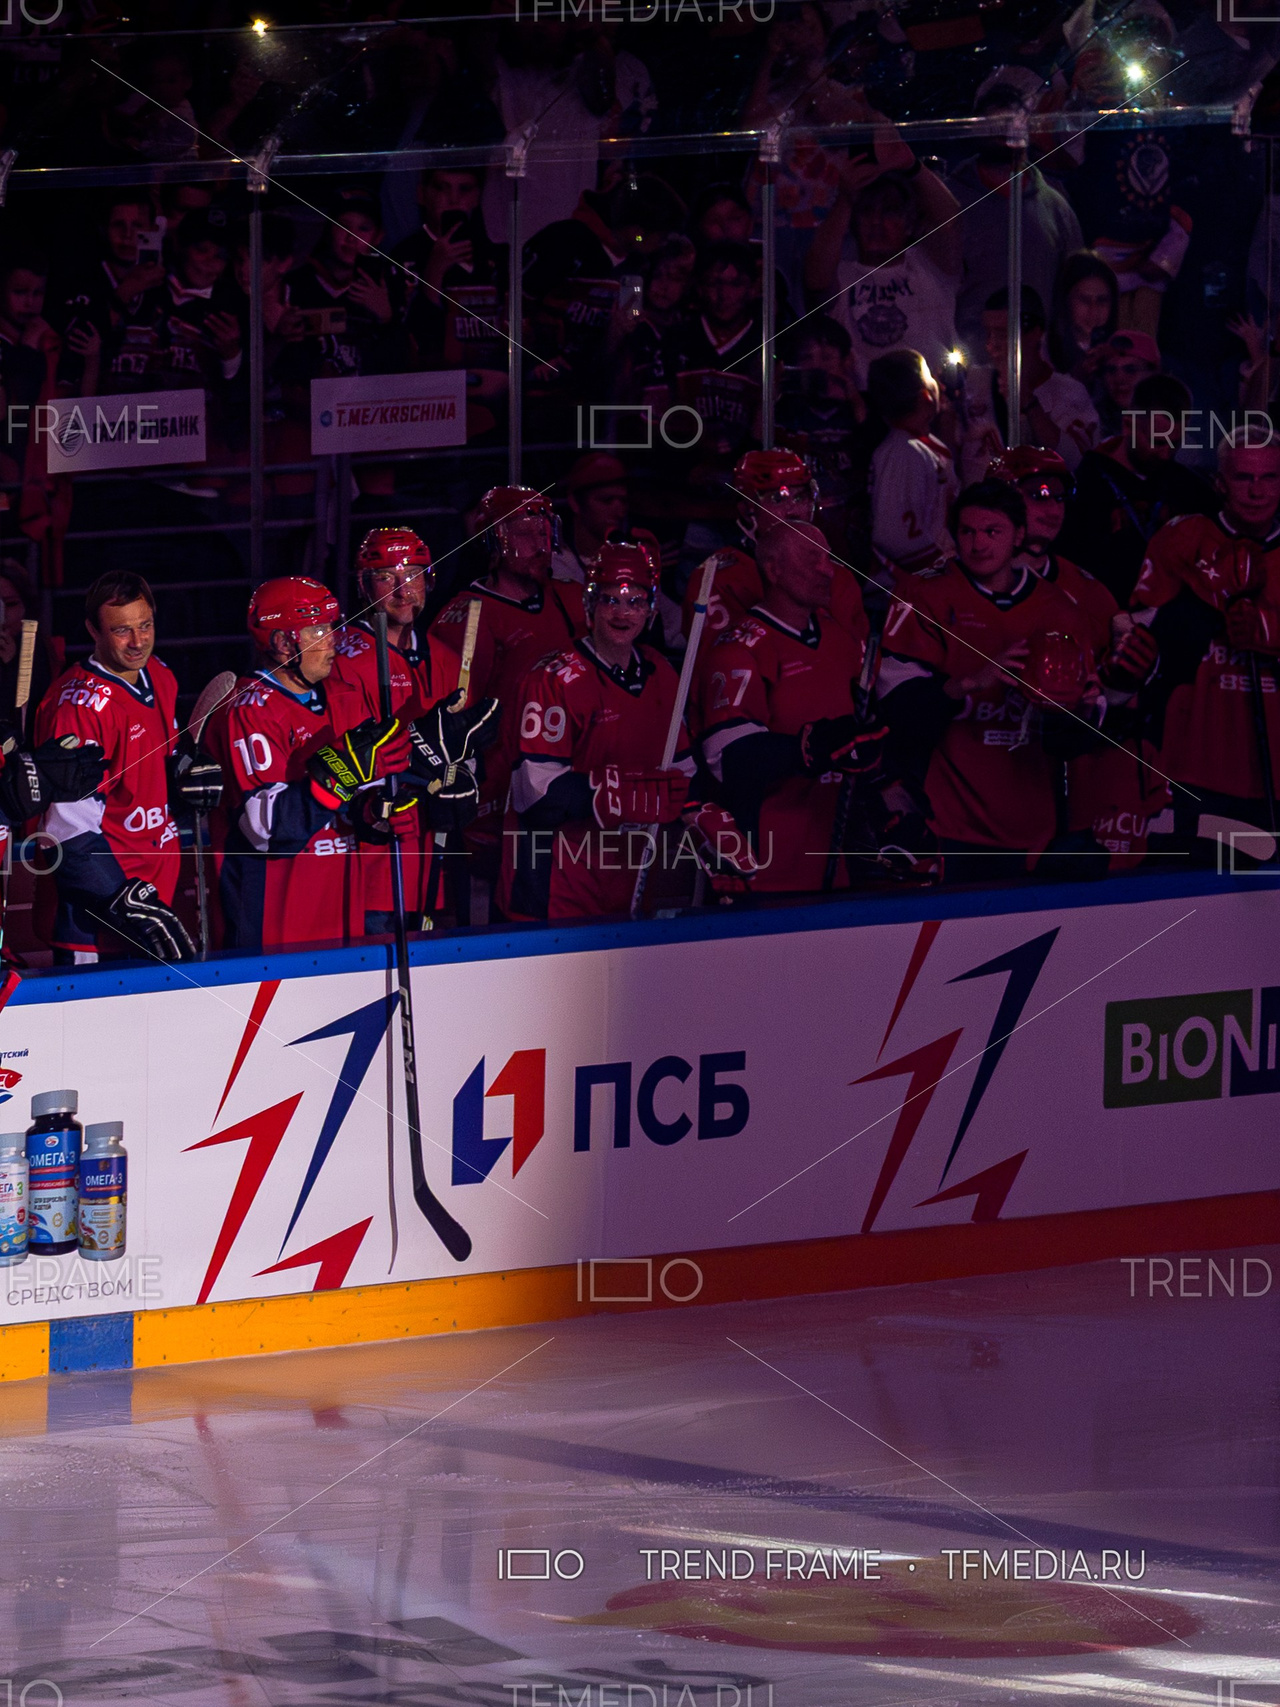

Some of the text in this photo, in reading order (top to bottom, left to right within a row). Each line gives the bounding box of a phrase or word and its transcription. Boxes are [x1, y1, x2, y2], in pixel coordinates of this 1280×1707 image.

[336, 402, 457, 428] T.ME/KRSCHINA
[58, 688, 110, 713] FON
[710, 668, 753, 709] 27
[520, 701, 567, 743] 69
[233, 732, 273, 776] 10
[573, 1050, 751, 1153] ПСБ
[6, 1279, 133, 1307] СРЕДСТВОМ
